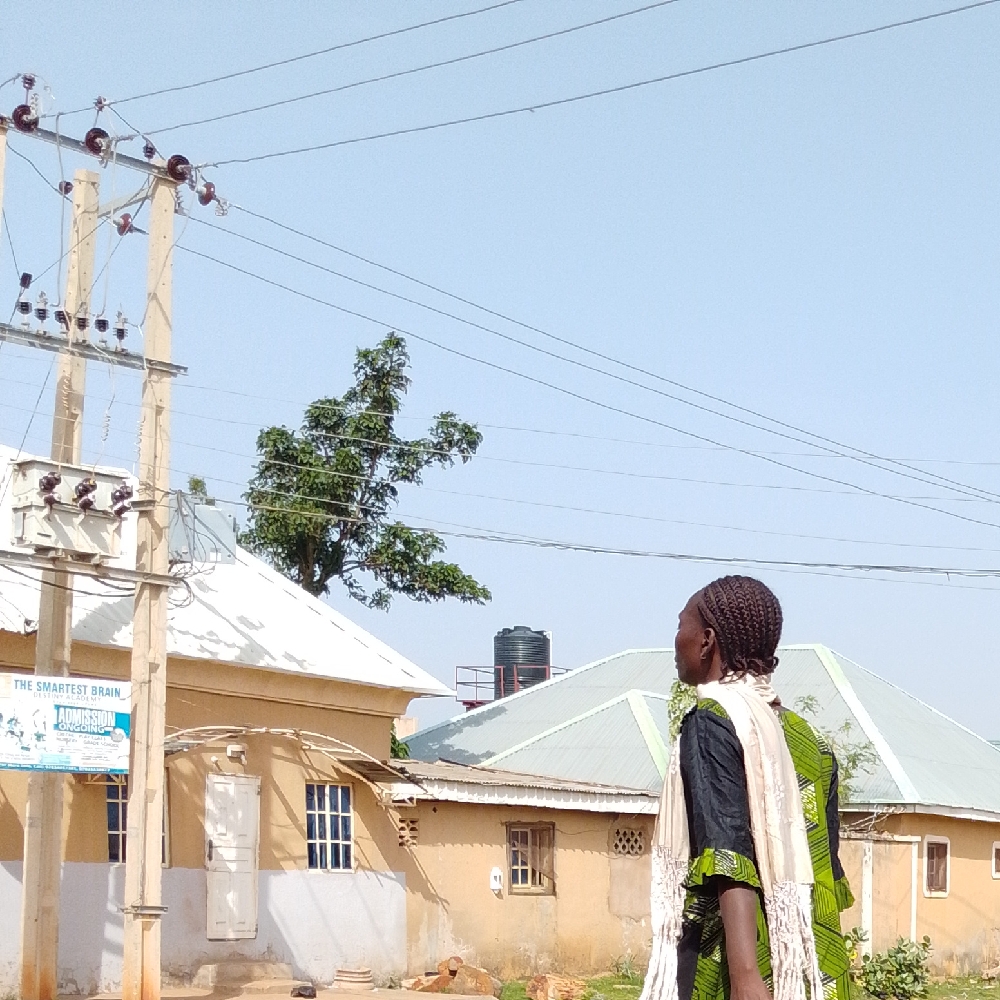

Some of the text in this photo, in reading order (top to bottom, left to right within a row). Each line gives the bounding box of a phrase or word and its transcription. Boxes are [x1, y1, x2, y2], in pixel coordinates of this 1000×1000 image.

[14, 679, 121, 698] THE SMARTEST BRAIN
[33, 691, 102, 702] DESTINY ACADEMY
[58, 707, 115, 727] ADMISSION
[58, 723, 105, 734] ONGOING
